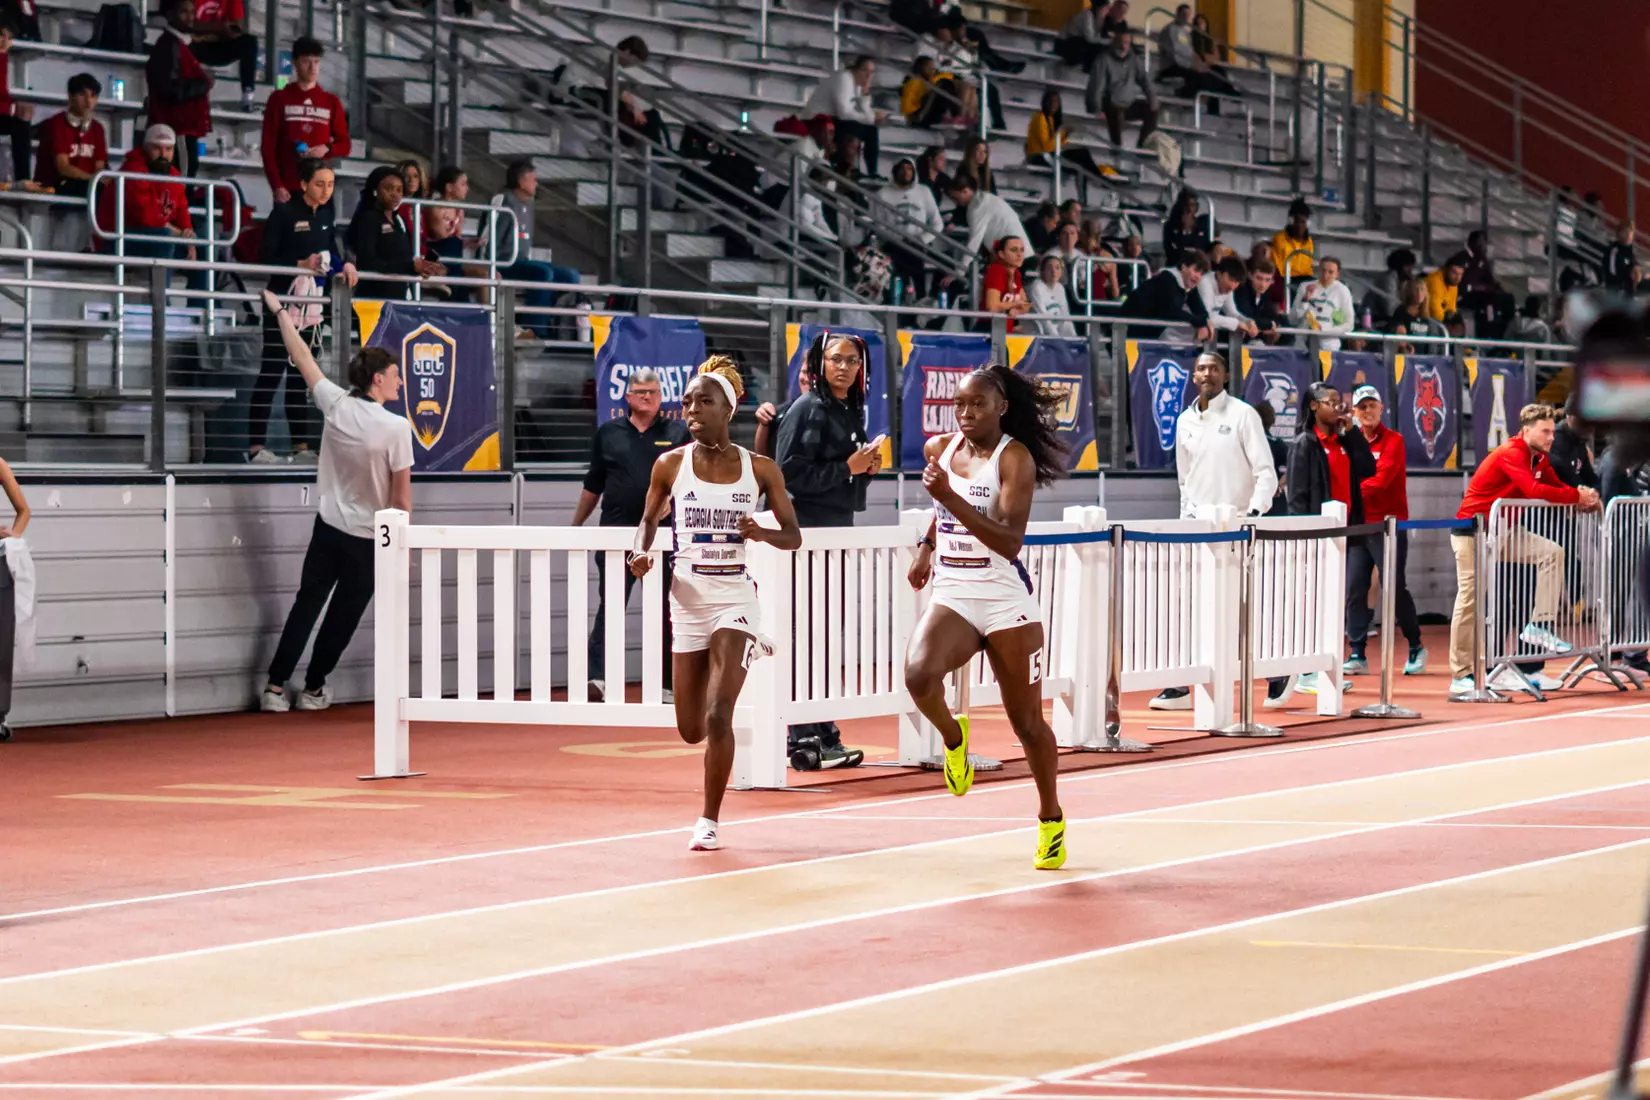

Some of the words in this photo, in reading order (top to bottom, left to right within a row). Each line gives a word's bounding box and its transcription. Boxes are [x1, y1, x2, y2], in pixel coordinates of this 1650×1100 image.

[420, 378, 435, 398] 50
[926, 370, 967, 399] RAG
[923, 404, 961, 433] CAJU
[684, 507, 711, 528] GEORGIA
[712, 509, 747, 530] SOUTHE
[380, 524, 391, 547] 3
[1033, 651, 1041, 681] 5
